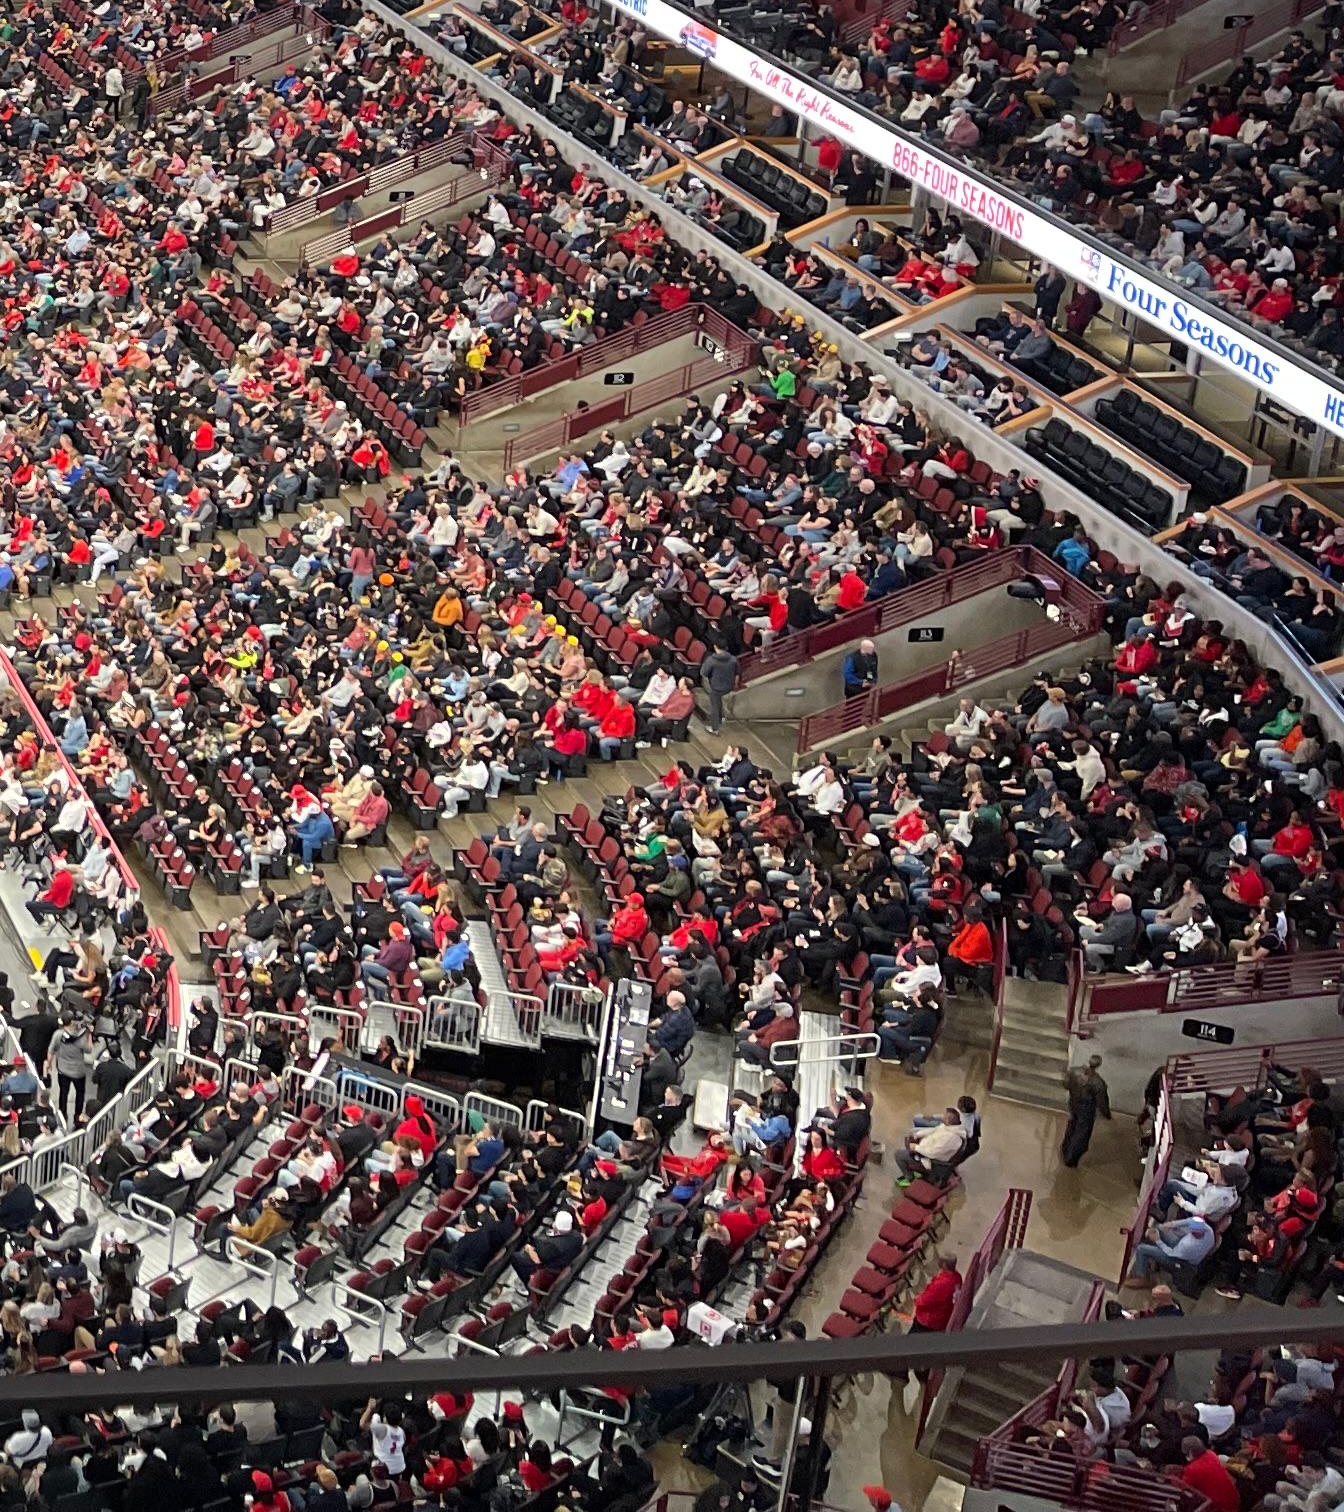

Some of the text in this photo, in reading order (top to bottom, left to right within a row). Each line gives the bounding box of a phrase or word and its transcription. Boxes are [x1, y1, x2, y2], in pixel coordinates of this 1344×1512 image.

[892, 142, 1274, 384] 866-FOUR SEASONS Four Seasons
